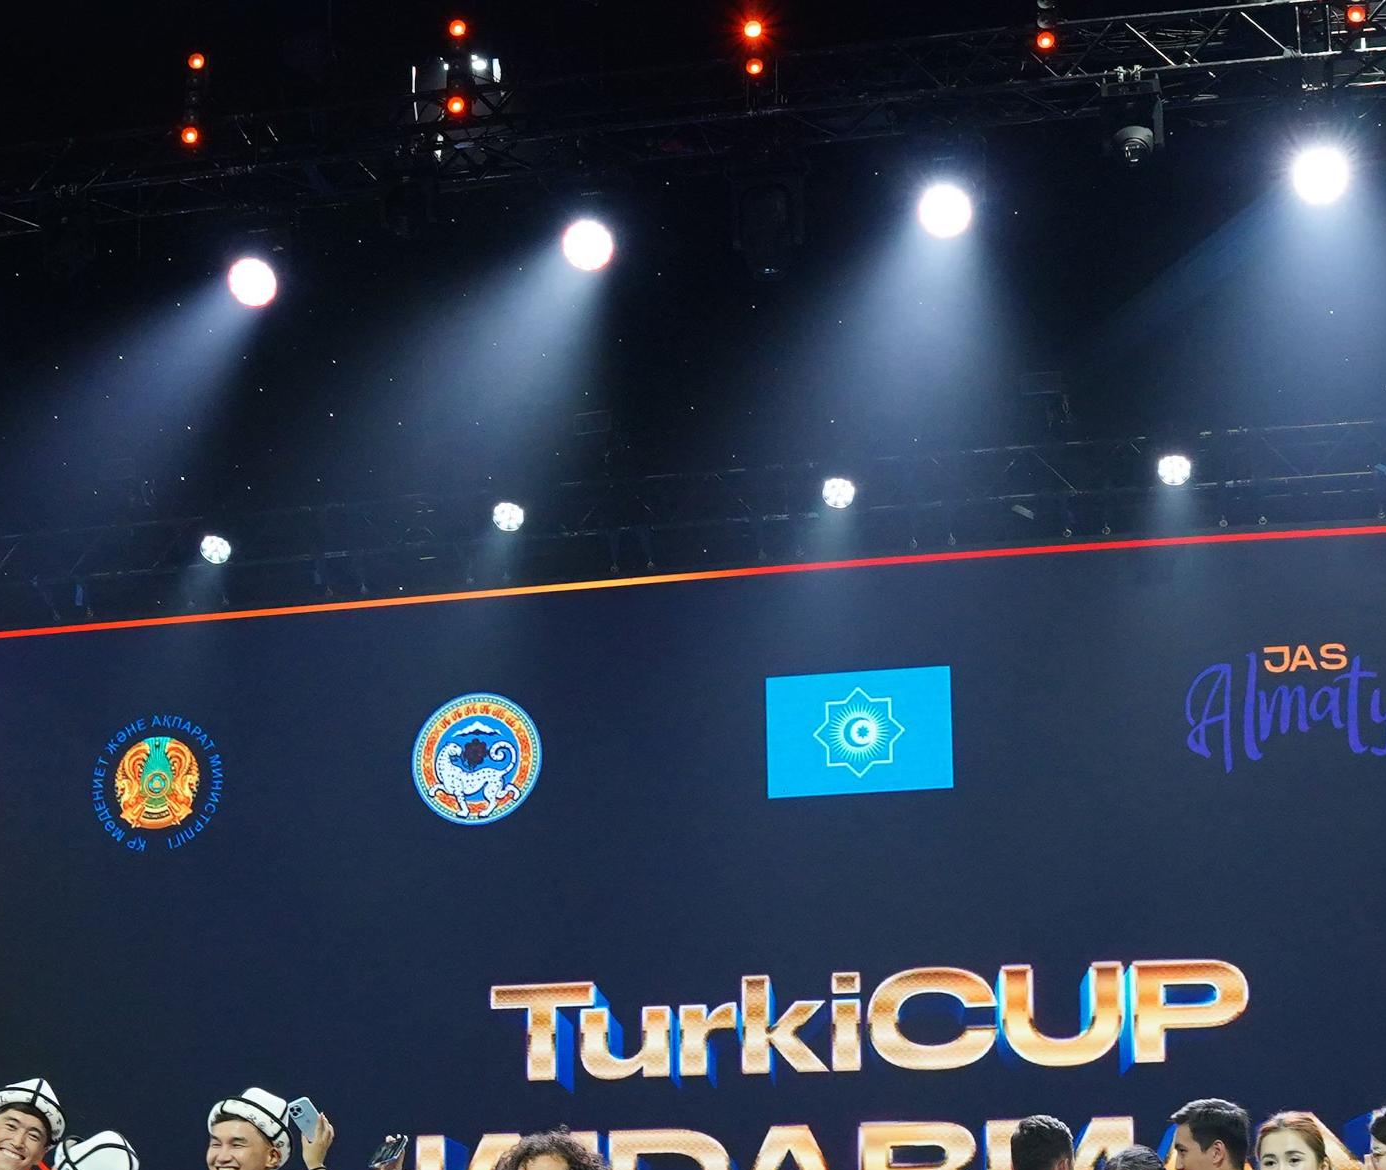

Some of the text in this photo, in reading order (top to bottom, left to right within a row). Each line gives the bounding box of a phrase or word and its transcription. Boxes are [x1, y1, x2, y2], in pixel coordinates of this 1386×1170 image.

[1263, 642, 1348, 673] JAS
[151, 715, 216, 751] АҚПАРАТ
[490, 956, 1251, 1090] TurkiCUP
